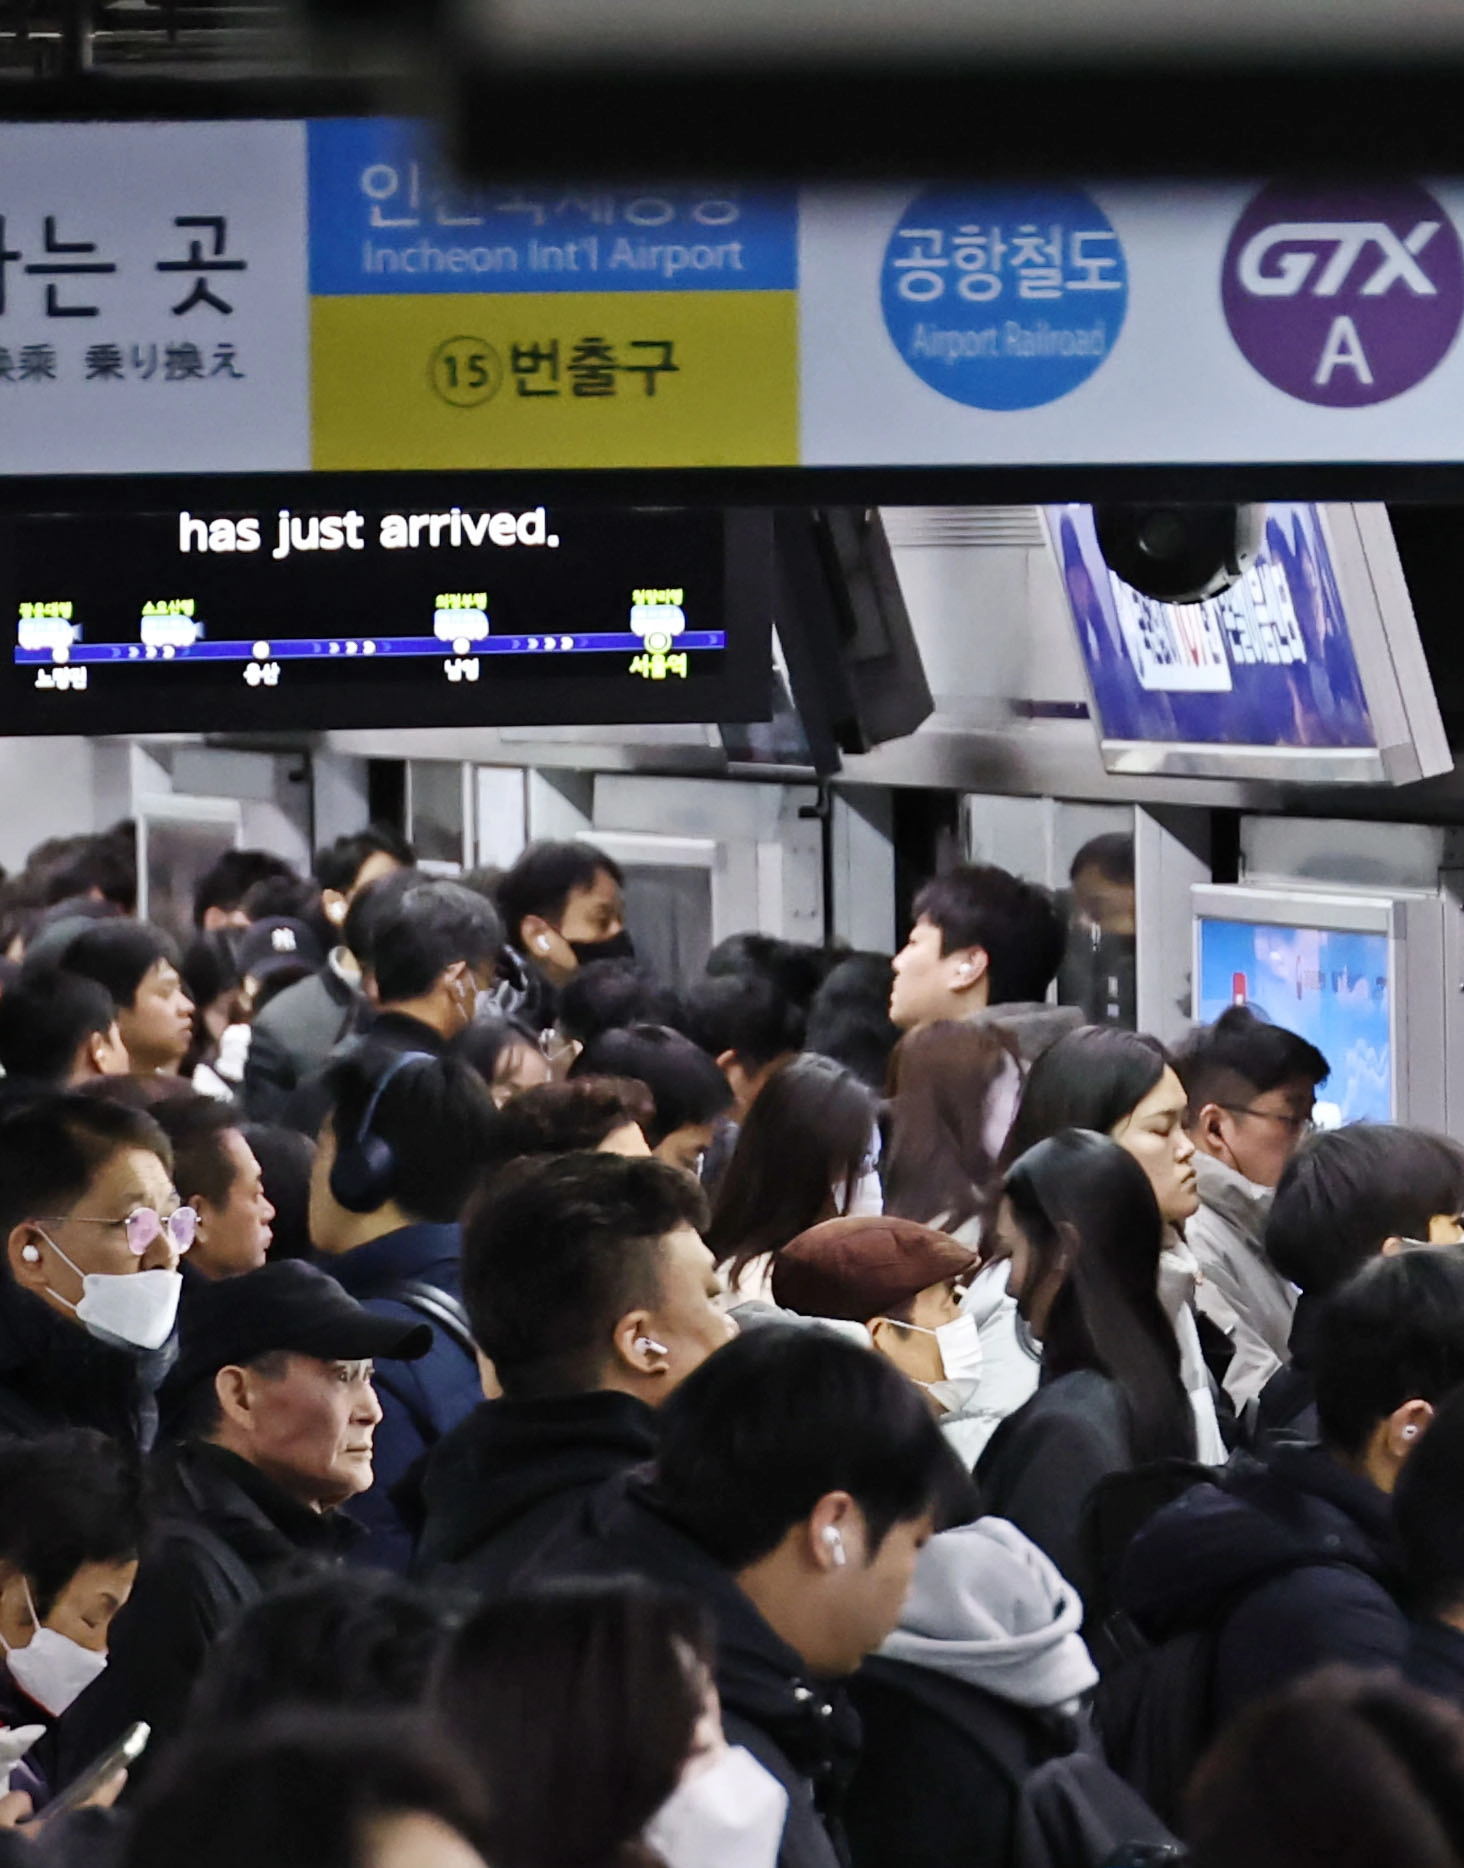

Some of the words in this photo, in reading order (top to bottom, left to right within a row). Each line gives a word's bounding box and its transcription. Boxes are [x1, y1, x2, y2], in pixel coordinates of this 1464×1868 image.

[156, 216, 247, 315] 곳
[362, 240, 518, 274] Incheon
[609, 235, 743, 278] Airport
[894, 226, 1122, 302] 공항철도
[1238, 222, 1439, 296] GTX
[912, 320, 999, 366] Airport
[1003, 319, 1107, 358] Railroad
[1315, 316, 1374, 385] A
[179, 511, 261, 553] has
[272, 510, 365, 560] just
[380, 506, 559, 548] arrived.
[628, 652, 688, 680] 서울역
